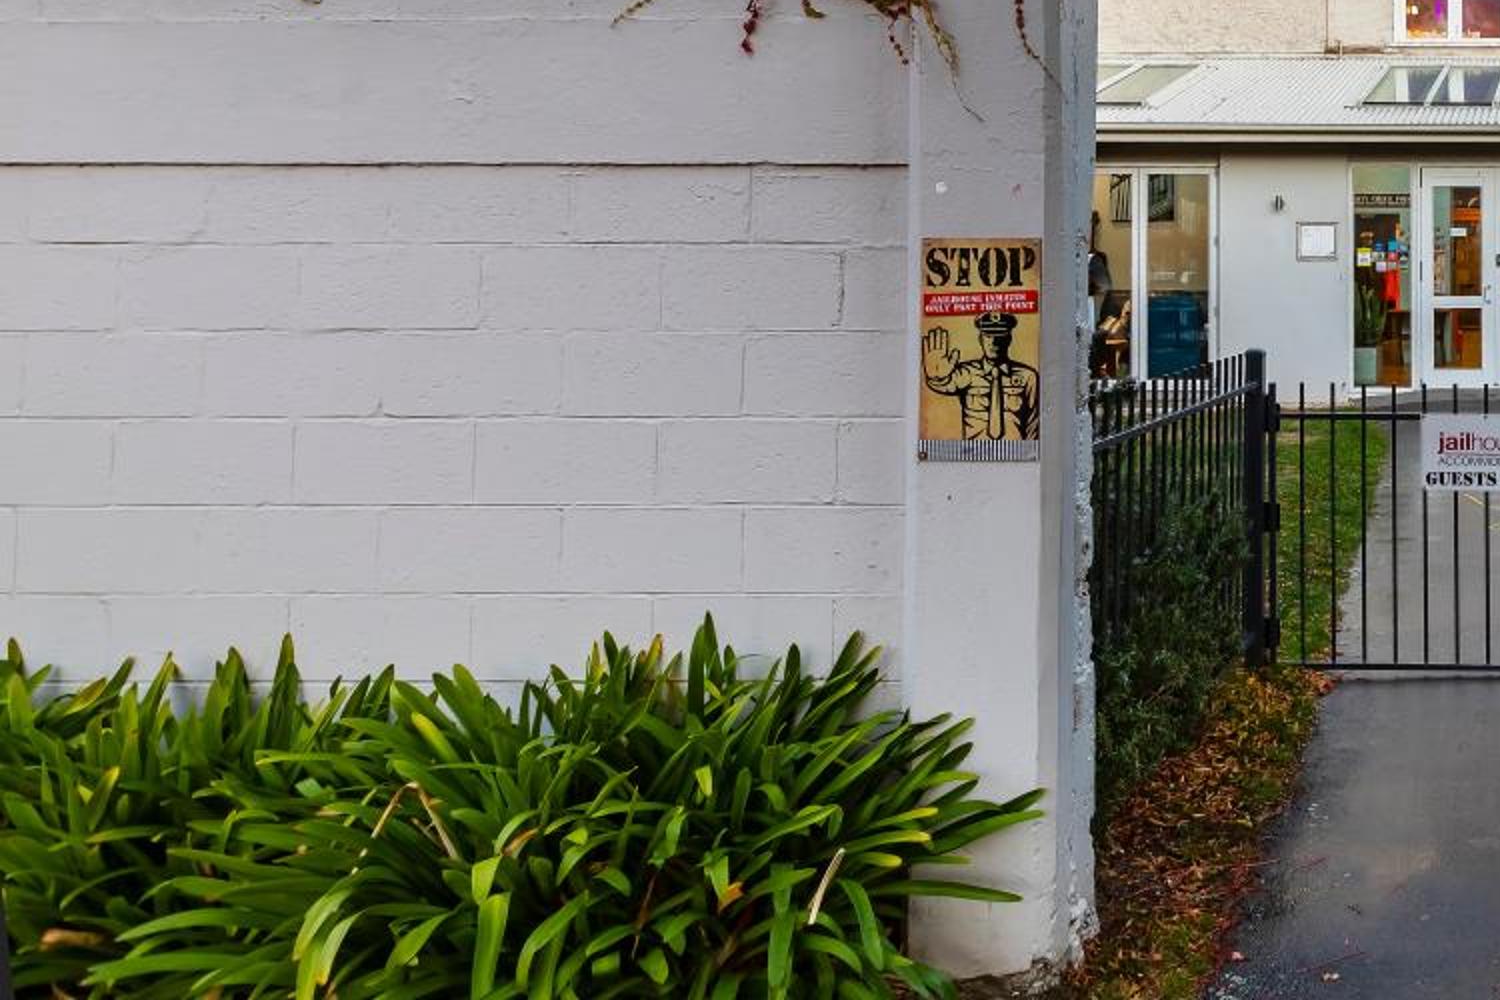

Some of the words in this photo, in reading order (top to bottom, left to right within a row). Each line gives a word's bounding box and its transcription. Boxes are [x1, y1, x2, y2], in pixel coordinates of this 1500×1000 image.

[926, 247, 1036, 287] STOP
[925, 303, 951, 313] ONLY
[953, 303, 976, 312] PAST
[981, 302, 1002, 311] THIS
[1005, 301, 1036, 310] POINT
[1425, 471, 1497, 486] GUESTS
